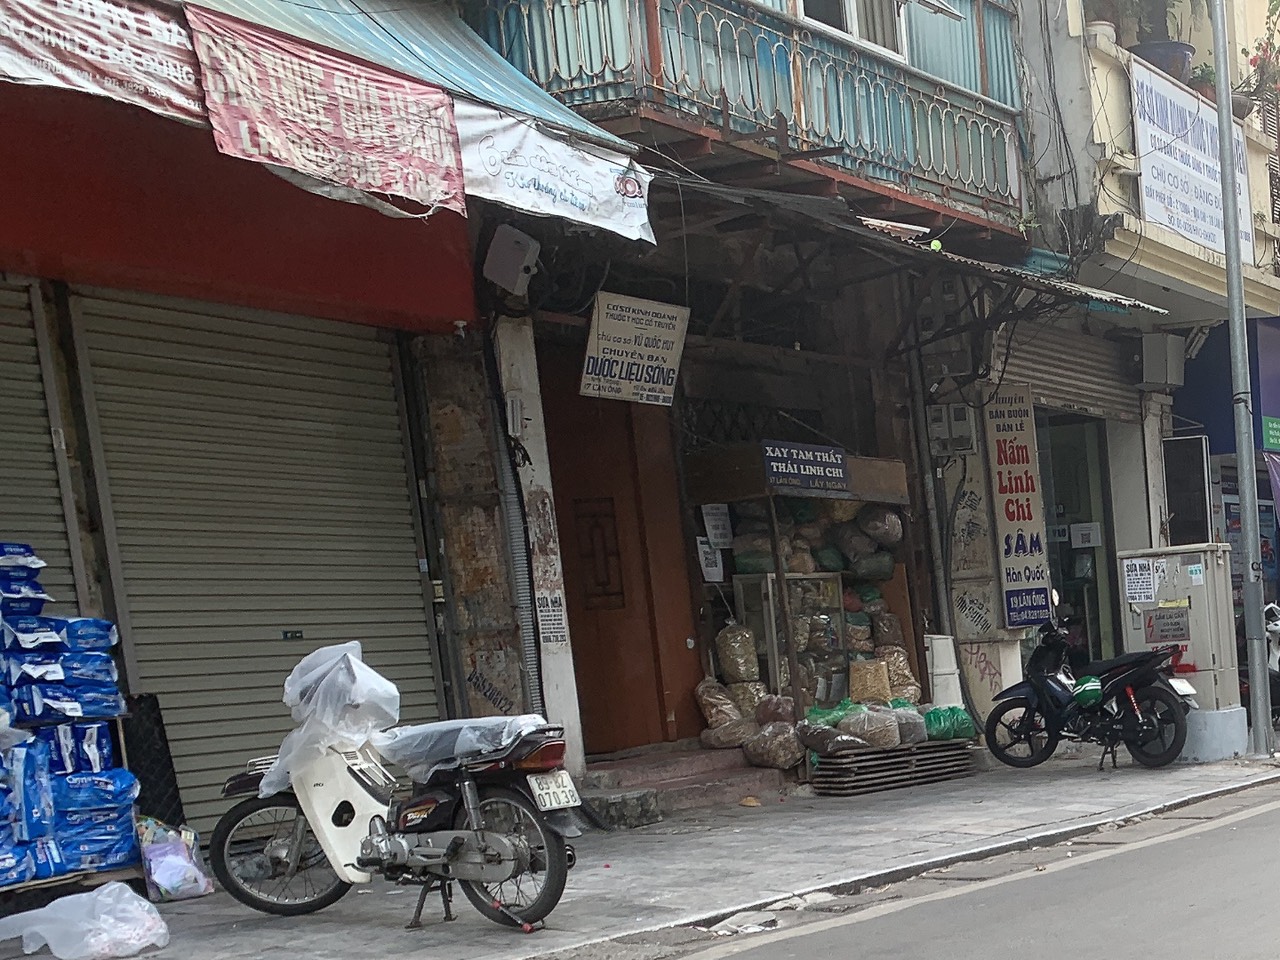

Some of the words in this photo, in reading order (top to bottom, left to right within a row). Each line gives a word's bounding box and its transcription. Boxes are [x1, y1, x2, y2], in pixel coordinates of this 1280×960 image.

[644, 363, 676, 387] SỐNG
[764, 446, 789, 458] XAY
[790, 448, 814, 461] TAM
[814, 449, 842, 464] THẤT
[996, 436, 1030, 466] Nấm
[770, 461, 799, 474] THÁI
[799, 464, 825, 477] LINH
[825, 467, 844, 478] CHI
[996, 469, 1036, 495] Linh
[1004, 498, 1034, 522] Chi
[1003, 527, 1044, 559] SÂM
[1005, 566, 1023, 583] Hàn
[1023, 563, 1045, 584] Quốc
[1125, 560, 1138, 574] SỬA
[1138, 560, 1151, 573] NHÀ
[537, 789, 577, 808] 070.38
